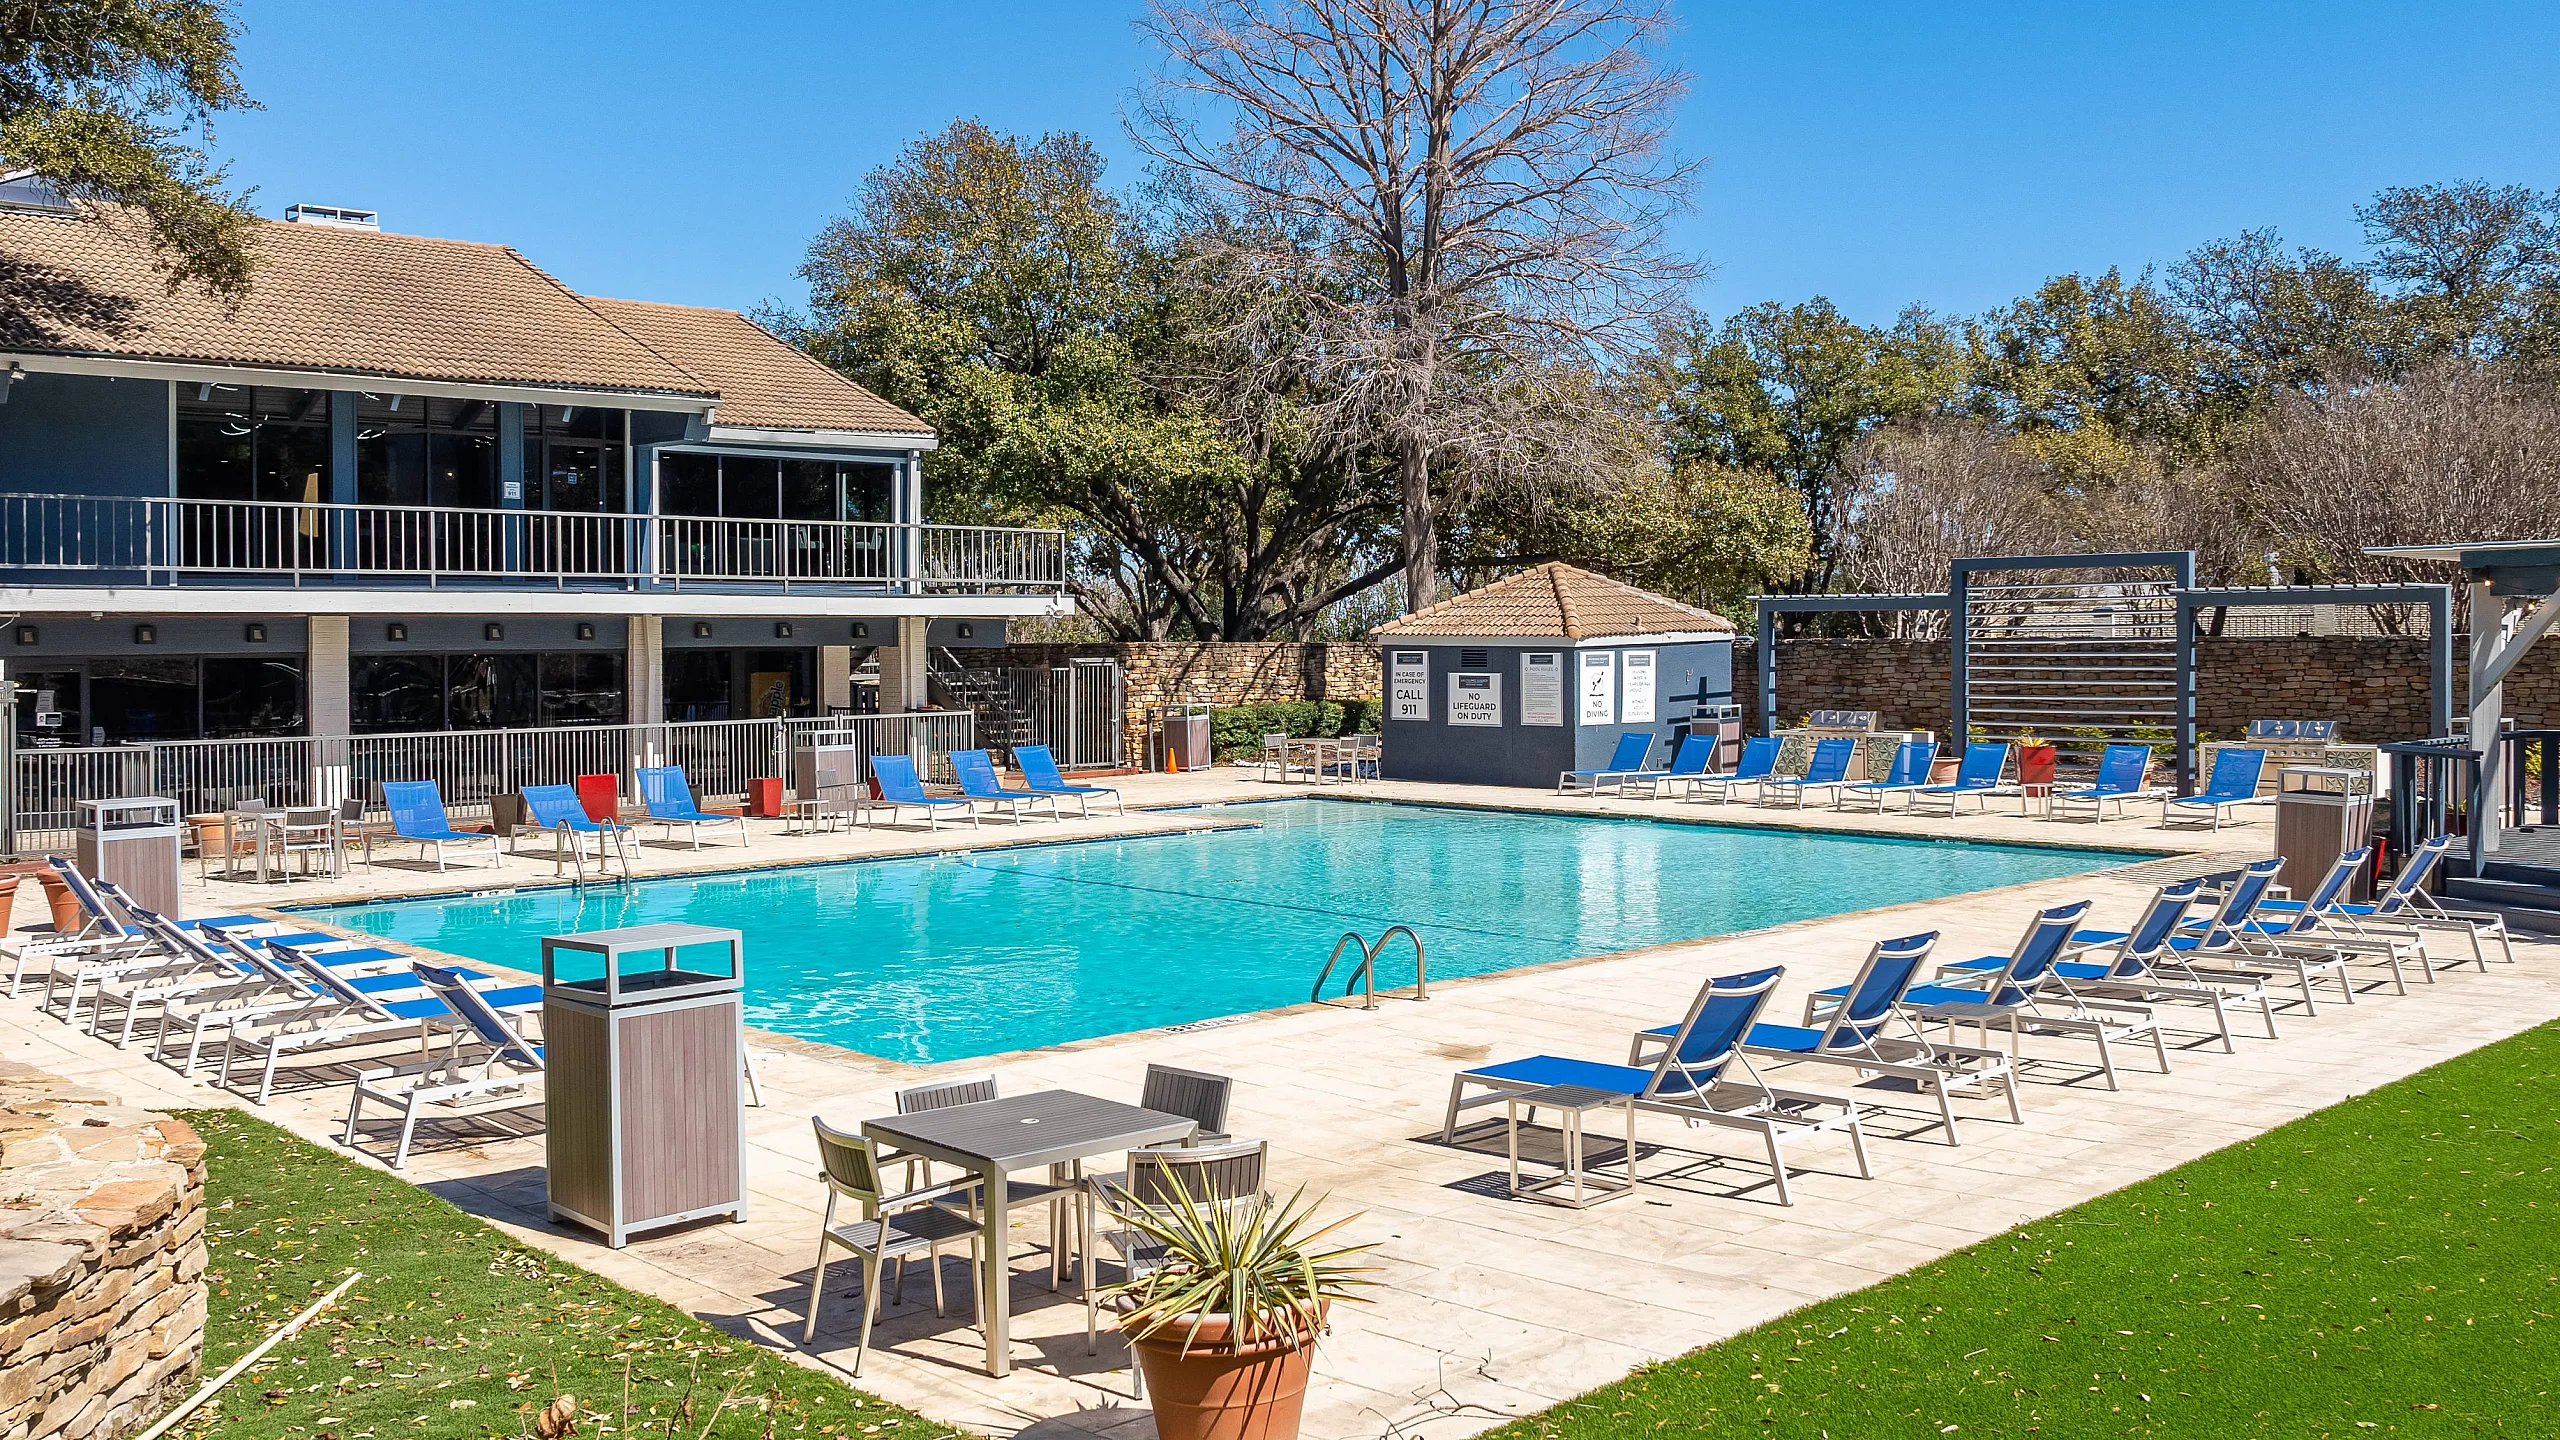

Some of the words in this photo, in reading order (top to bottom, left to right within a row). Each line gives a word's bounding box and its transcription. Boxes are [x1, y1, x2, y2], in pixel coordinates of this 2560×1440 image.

[769, 680, 784, 717] apple
[1397, 690, 1423, 700] CALL
[1402, 704, 1416, 715] 911
[1453, 702, 1496, 710] LIFEGUARD
[1458, 712, 1468, 720] ON
[1471, 712, 1491, 720] DUTY
[1587, 710, 1608, 718] DIVING
